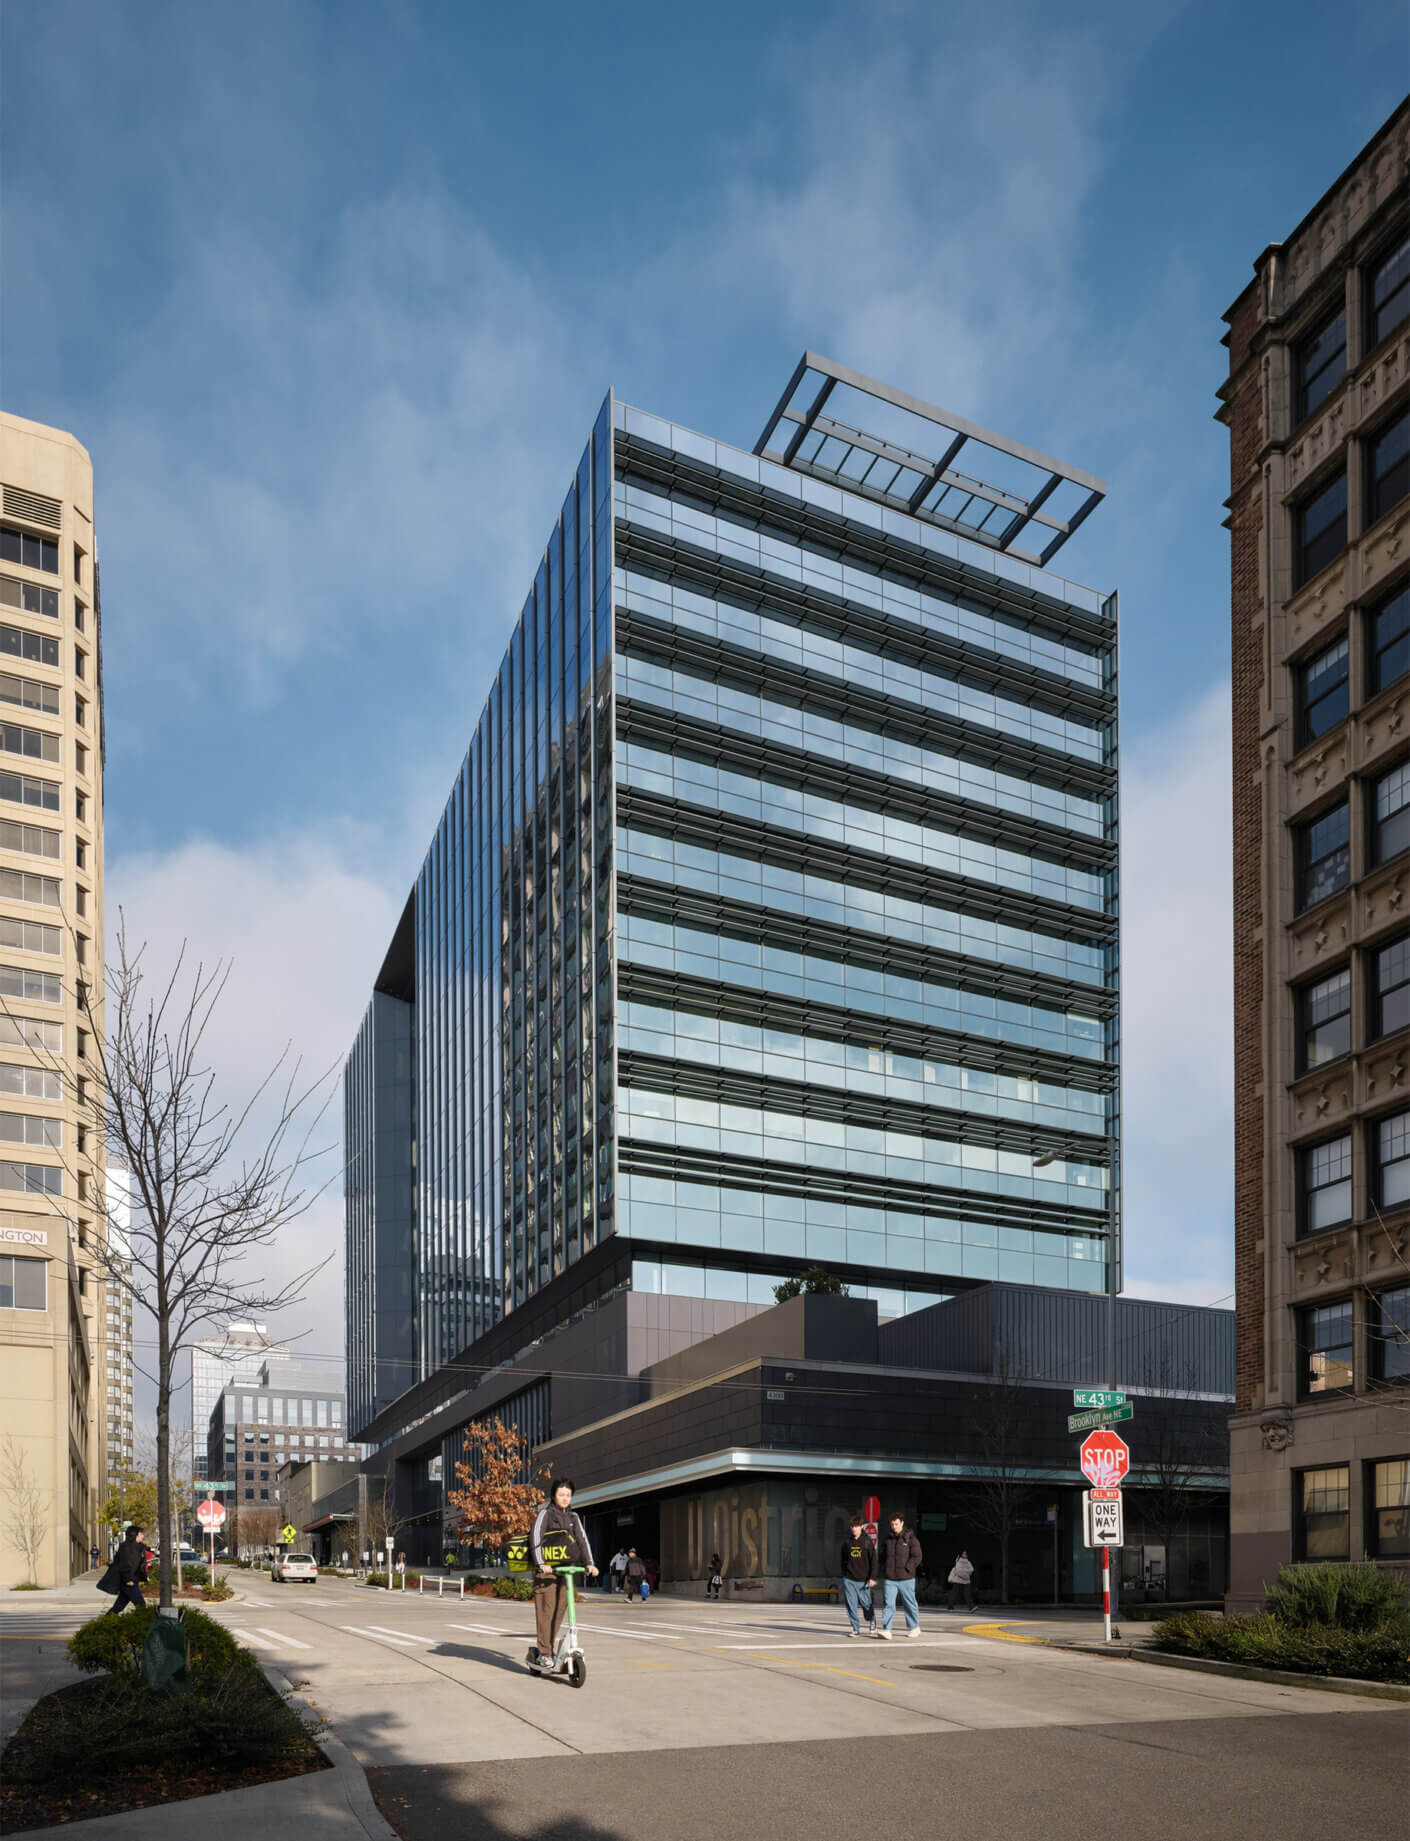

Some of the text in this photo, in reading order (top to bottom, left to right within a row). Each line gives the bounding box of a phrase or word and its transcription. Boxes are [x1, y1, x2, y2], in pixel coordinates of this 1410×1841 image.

[1076, 1394, 1087, 1403] NE
[1069, 1409, 1122, 1429] Brooklyn Ave NE
[1084, 1448, 1125, 1470] STOP
[1095, 1504, 1116, 1515] ONE
[1095, 1517, 1116, 1527] WAY
[714, 1487, 865, 1577] Distric
